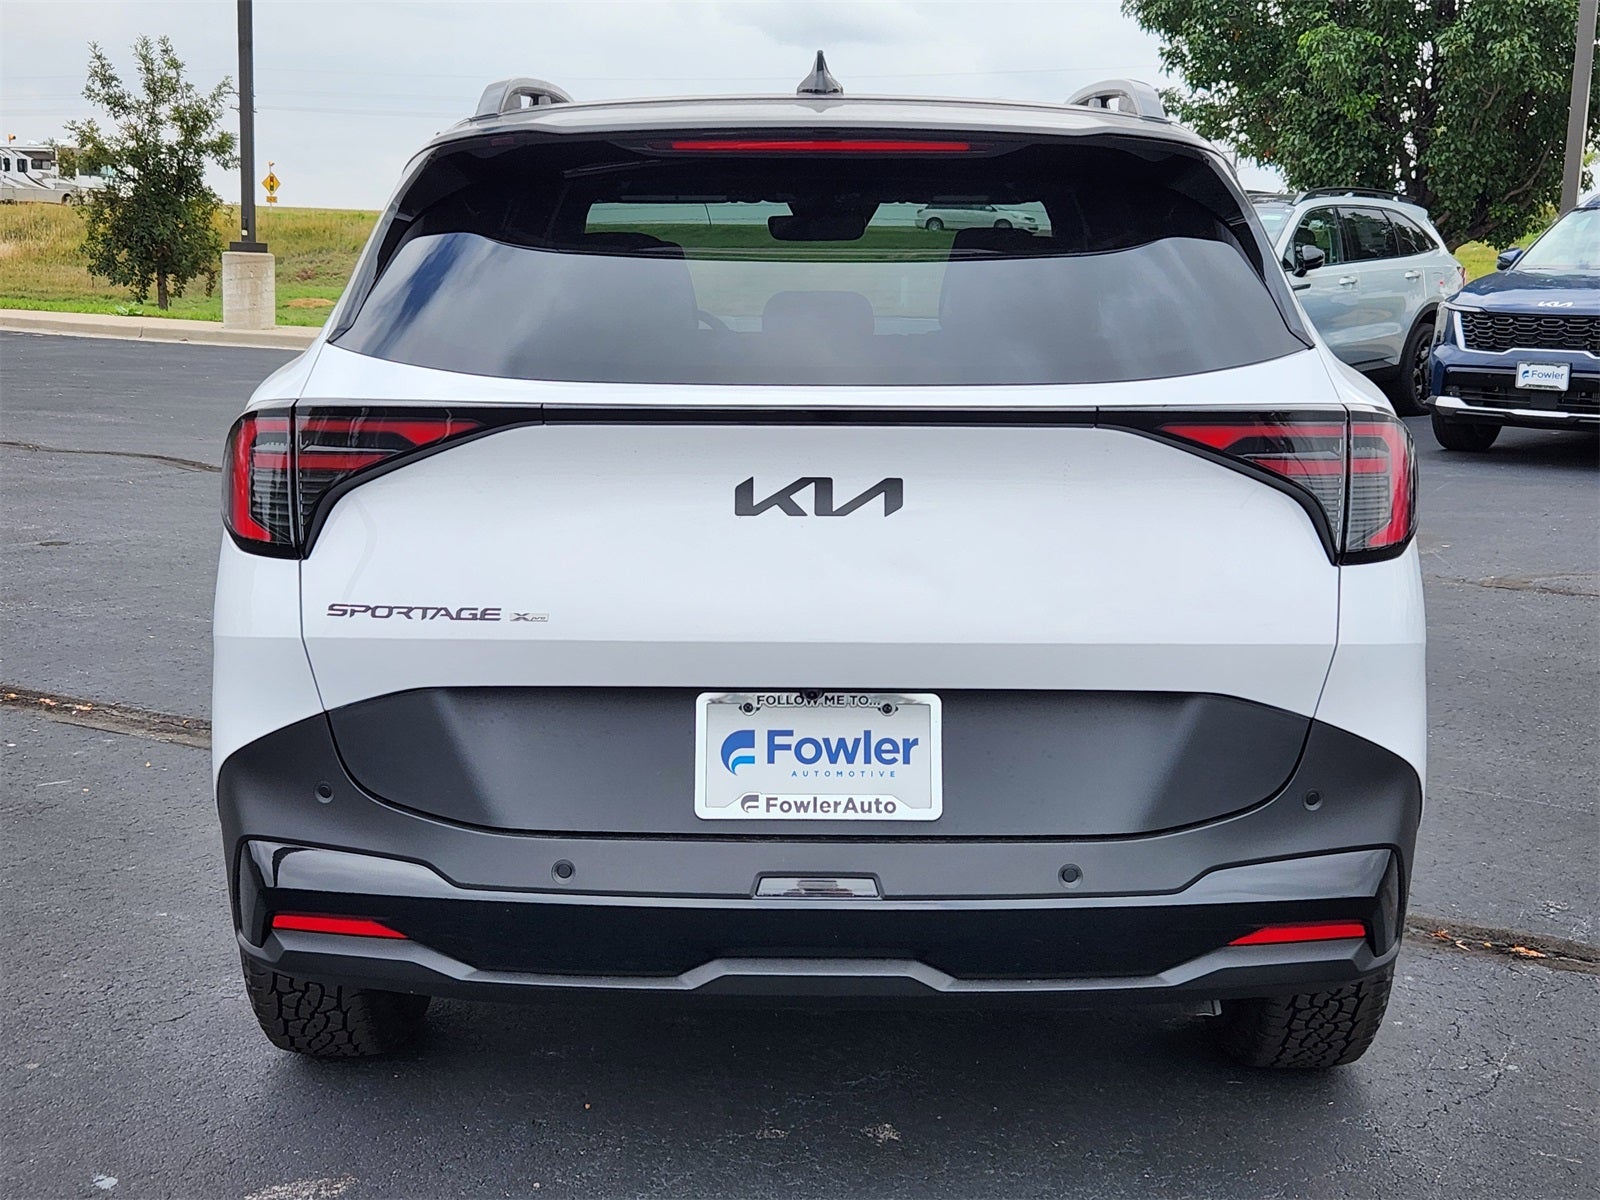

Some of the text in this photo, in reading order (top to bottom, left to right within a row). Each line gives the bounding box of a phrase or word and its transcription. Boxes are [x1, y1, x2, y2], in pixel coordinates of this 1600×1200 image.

[1531, 370, 1564, 379] Fowler
[735, 476, 903, 517] KIA
[326, 603, 502, 621] SPORTAGE
[825, 695, 844, 706] ME
[767, 730, 919, 765] Fowler
[791, 770, 896, 778] AUTOMOTIVE
[765, 797, 897, 814] FowlerAuto
